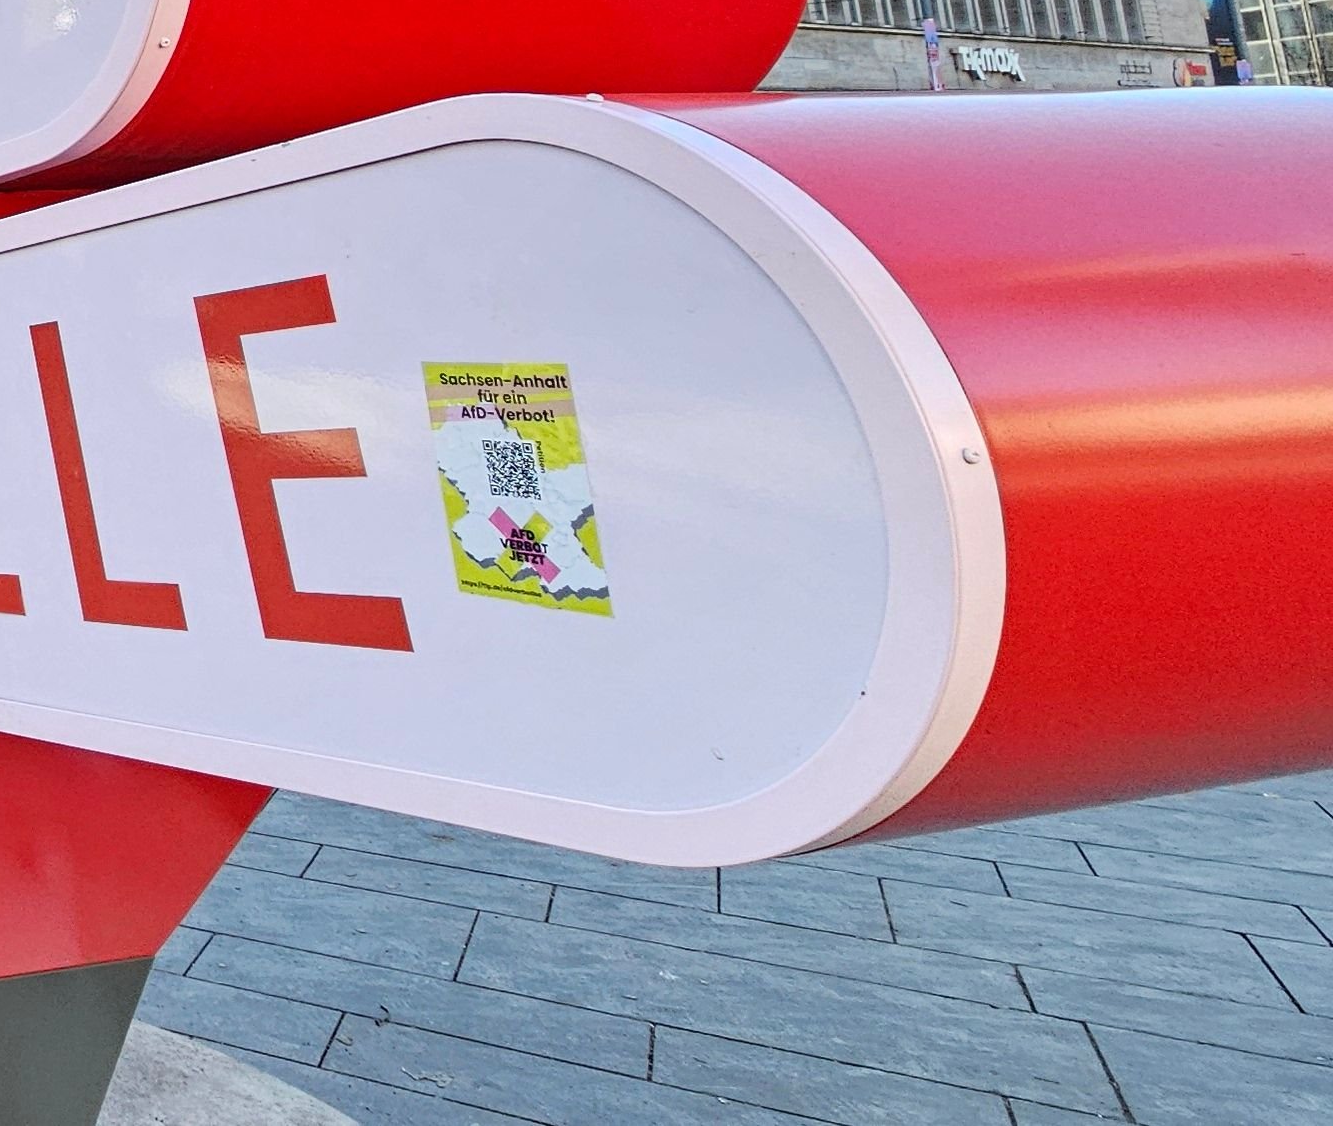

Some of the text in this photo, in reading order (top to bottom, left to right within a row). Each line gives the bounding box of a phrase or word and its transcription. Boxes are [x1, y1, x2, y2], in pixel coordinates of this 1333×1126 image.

[439, 372, 568, 389] Sachsen-Anhalt
[478, 388, 528, 405] für ein
[461, 405, 556, 423] AfD-Verbot!
[511, 528, 535, 541] AFD
[499, 538, 548, 554] VERBOT
[509, 550, 545, 565] JETZT
